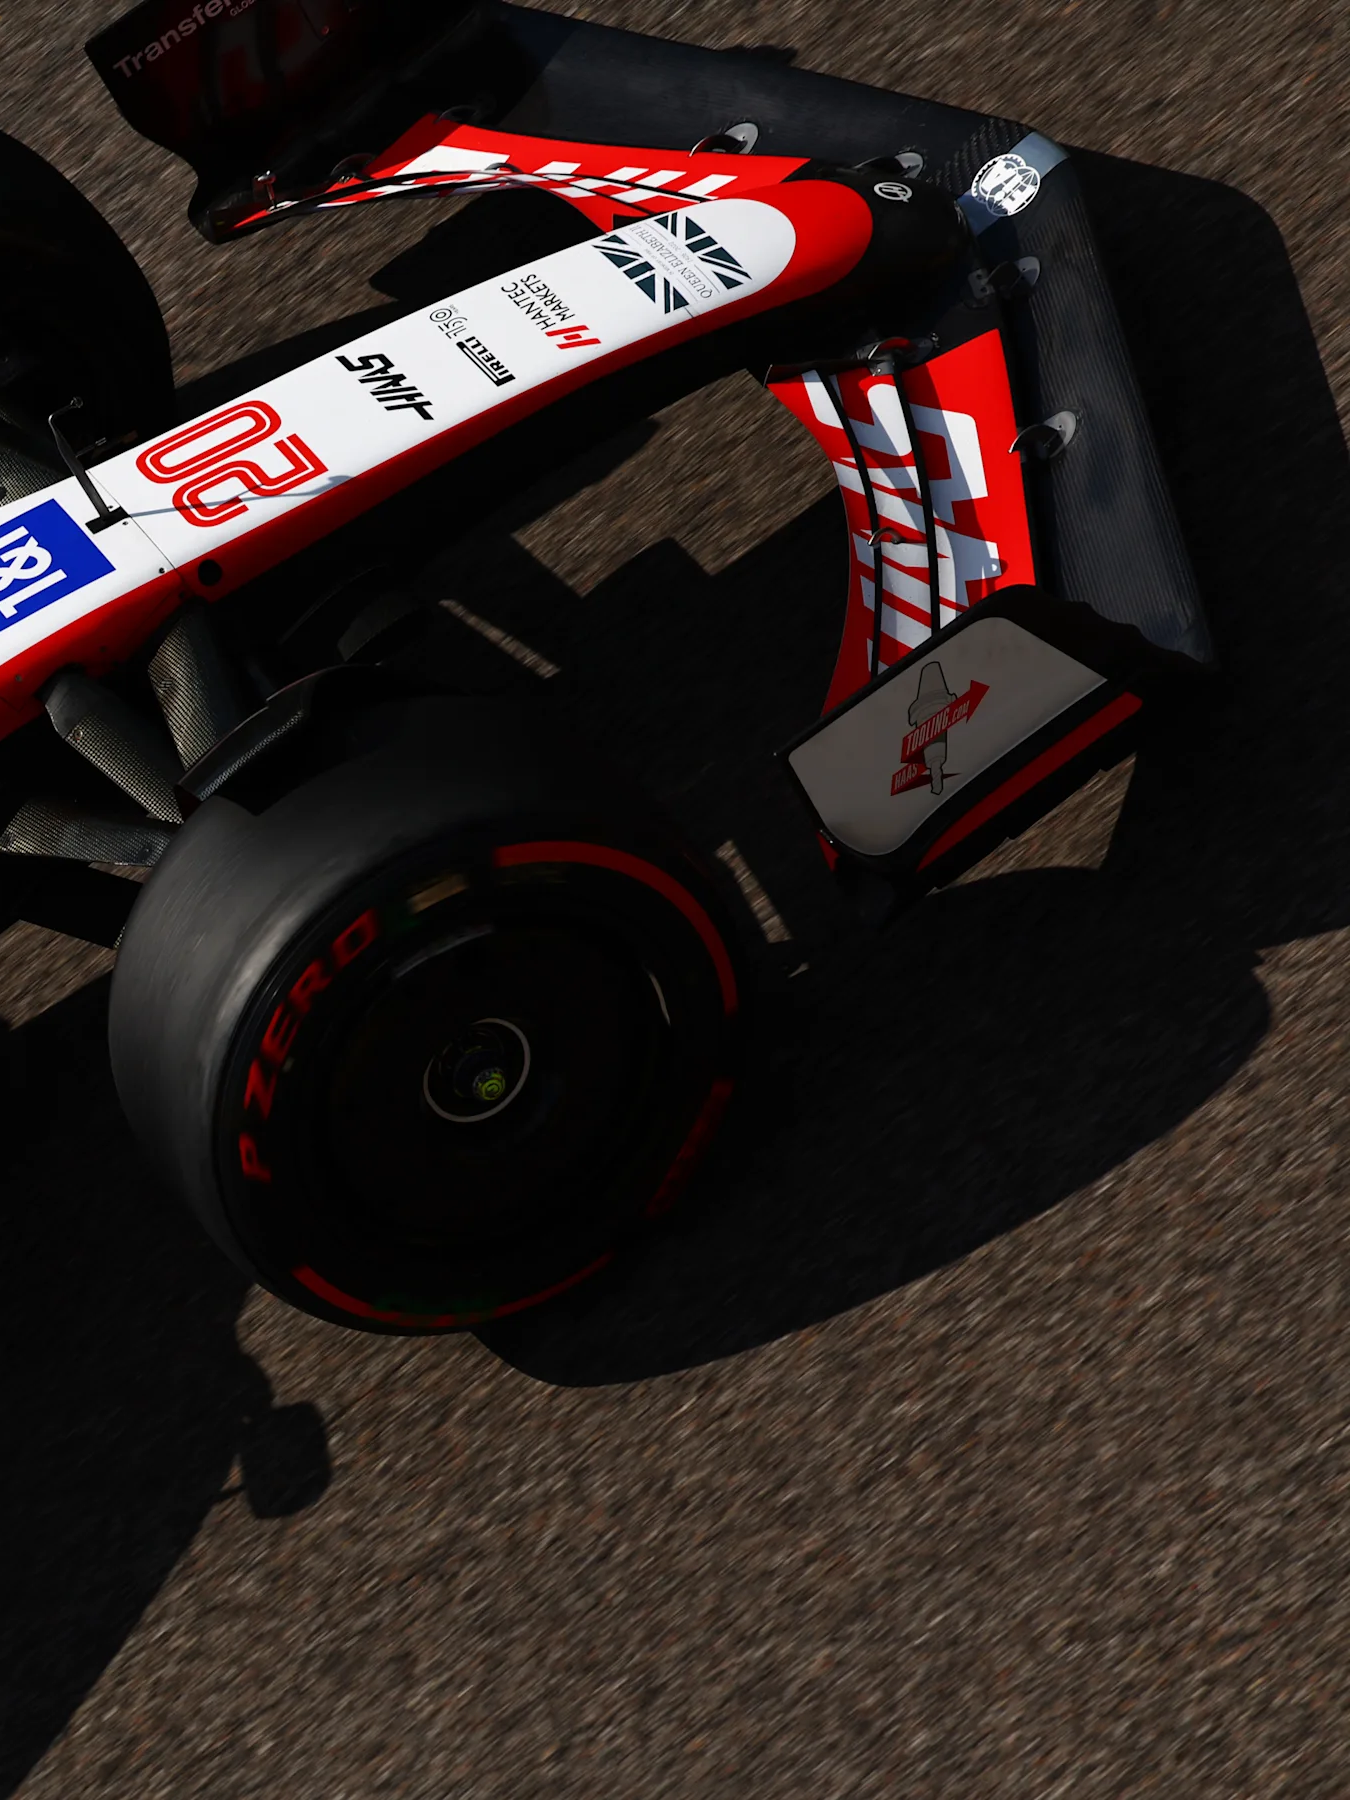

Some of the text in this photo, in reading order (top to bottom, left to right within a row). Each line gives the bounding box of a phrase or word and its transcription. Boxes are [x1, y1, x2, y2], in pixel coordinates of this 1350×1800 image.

[635, 228, 684, 268] ELIZABETH
[501, 282, 556, 330] HANTEC
[520, 273, 576, 321] MARKETS
[678, 266, 713, 299] QUEEN
[456, 336, 516, 387] PIRELLI
[334, 353, 435, 420] HAAS
[135, 400, 329, 528] 20
[894, 763, 918, 791] HAAS
[244, 908, 379, 1121] ZERO
